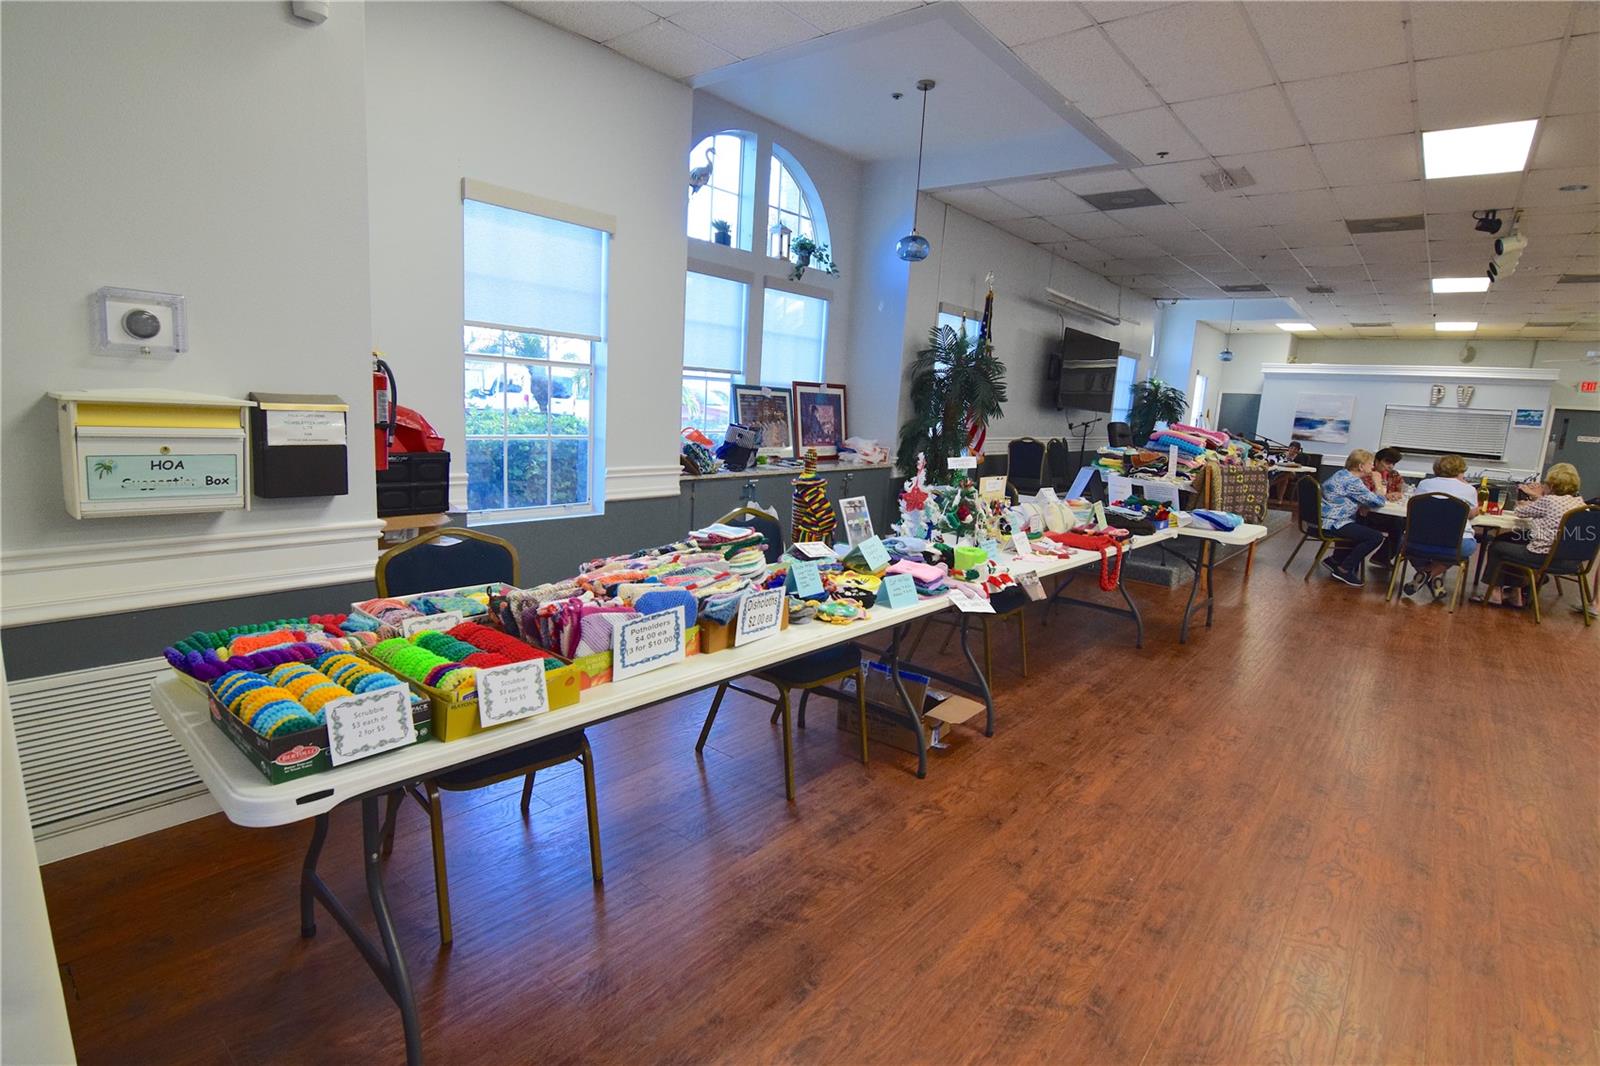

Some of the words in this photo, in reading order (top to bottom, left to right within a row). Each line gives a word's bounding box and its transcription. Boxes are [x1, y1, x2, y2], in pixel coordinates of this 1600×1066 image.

[1582, 382, 1597, 392] EXIT
[151, 460, 185, 471] HOA
[206, 476, 230, 487] Box
[747, 597, 778, 612] Dishcloths
[748, 613, 766, 628] $2.00
[766, 613, 773, 623] ea
[631, 620, 671, 636] Potholders
[635, 632, 656, 643] $4.00
[636, 644, 646, 652] for
[501, 677, 526, 686] Scrubbie
[354, 706, 384, 719] Scrubbie
[352, 721, 361, 730] $3
[362, 718, 379, 727] each
[358, 730, 363, 738] 2
[364, 727, 375, 736] for
[376, 725, 385, 733] $5
